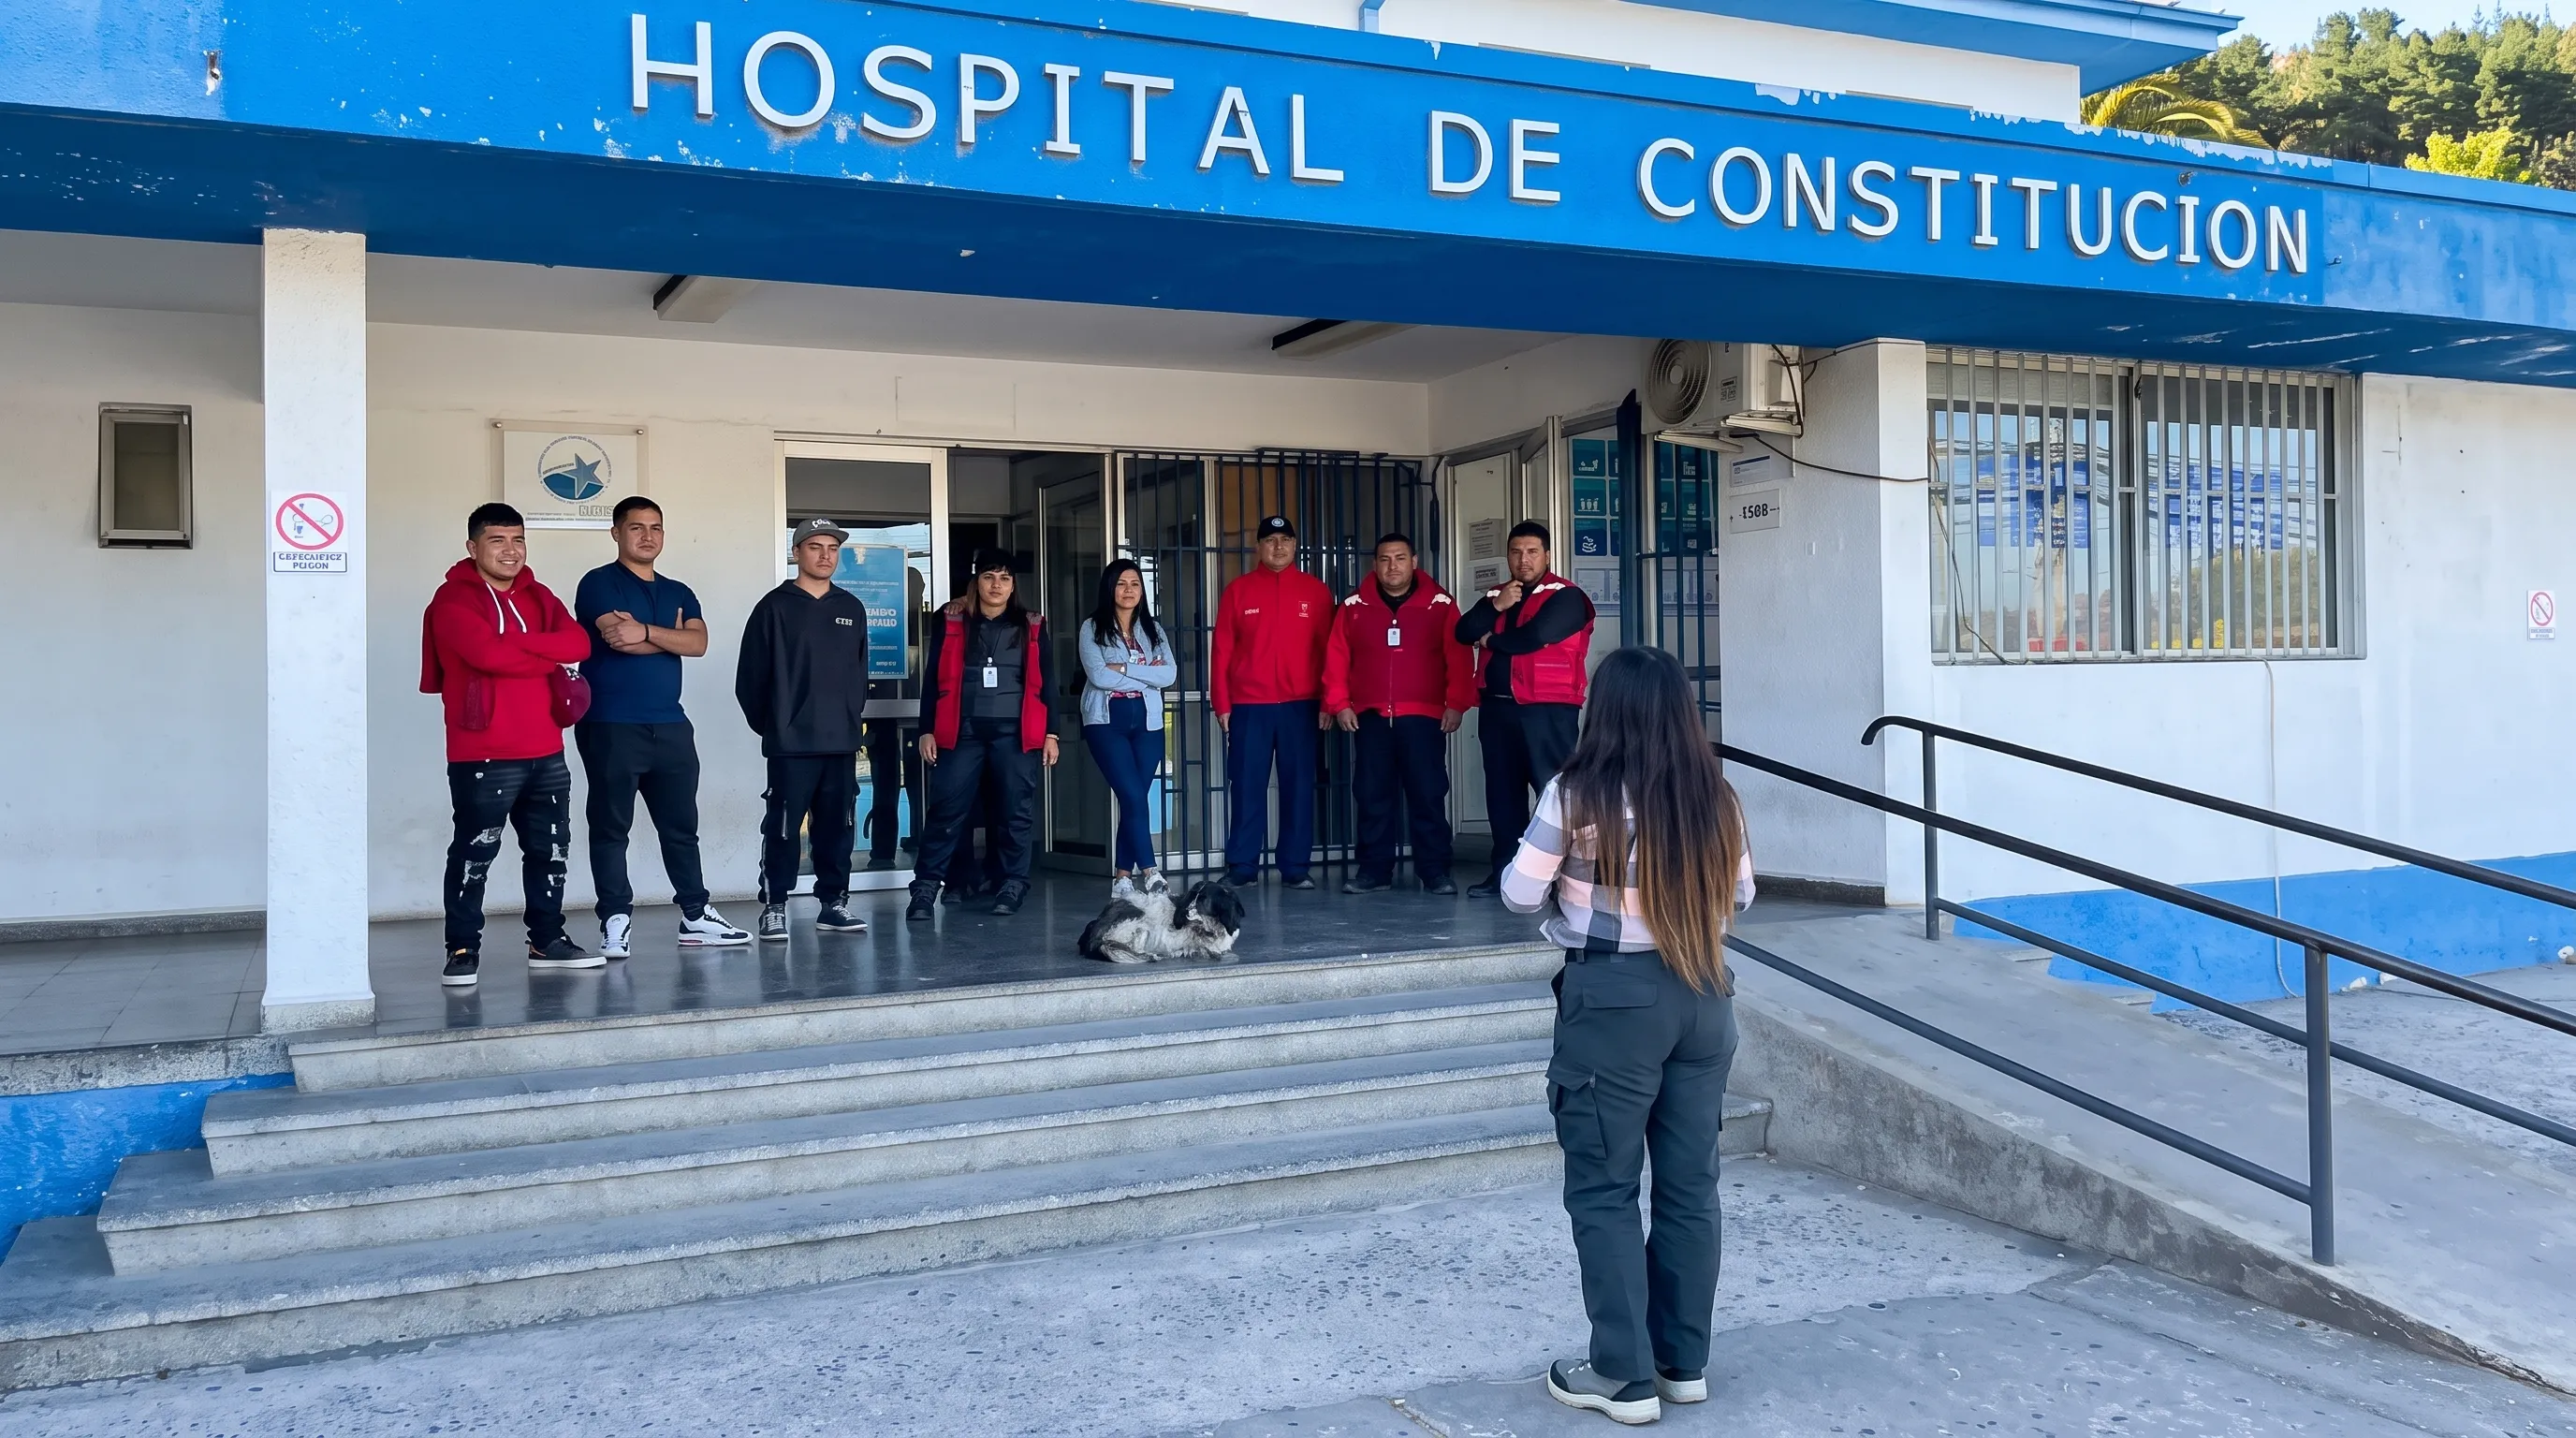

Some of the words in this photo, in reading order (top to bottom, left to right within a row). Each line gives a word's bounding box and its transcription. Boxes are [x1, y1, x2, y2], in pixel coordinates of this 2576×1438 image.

[631, 13, 1344, 183] HOSPITAL
[1428, 109, 1561, 202] DE
[1637, 137, 2309, 273] CONSTITUCION
